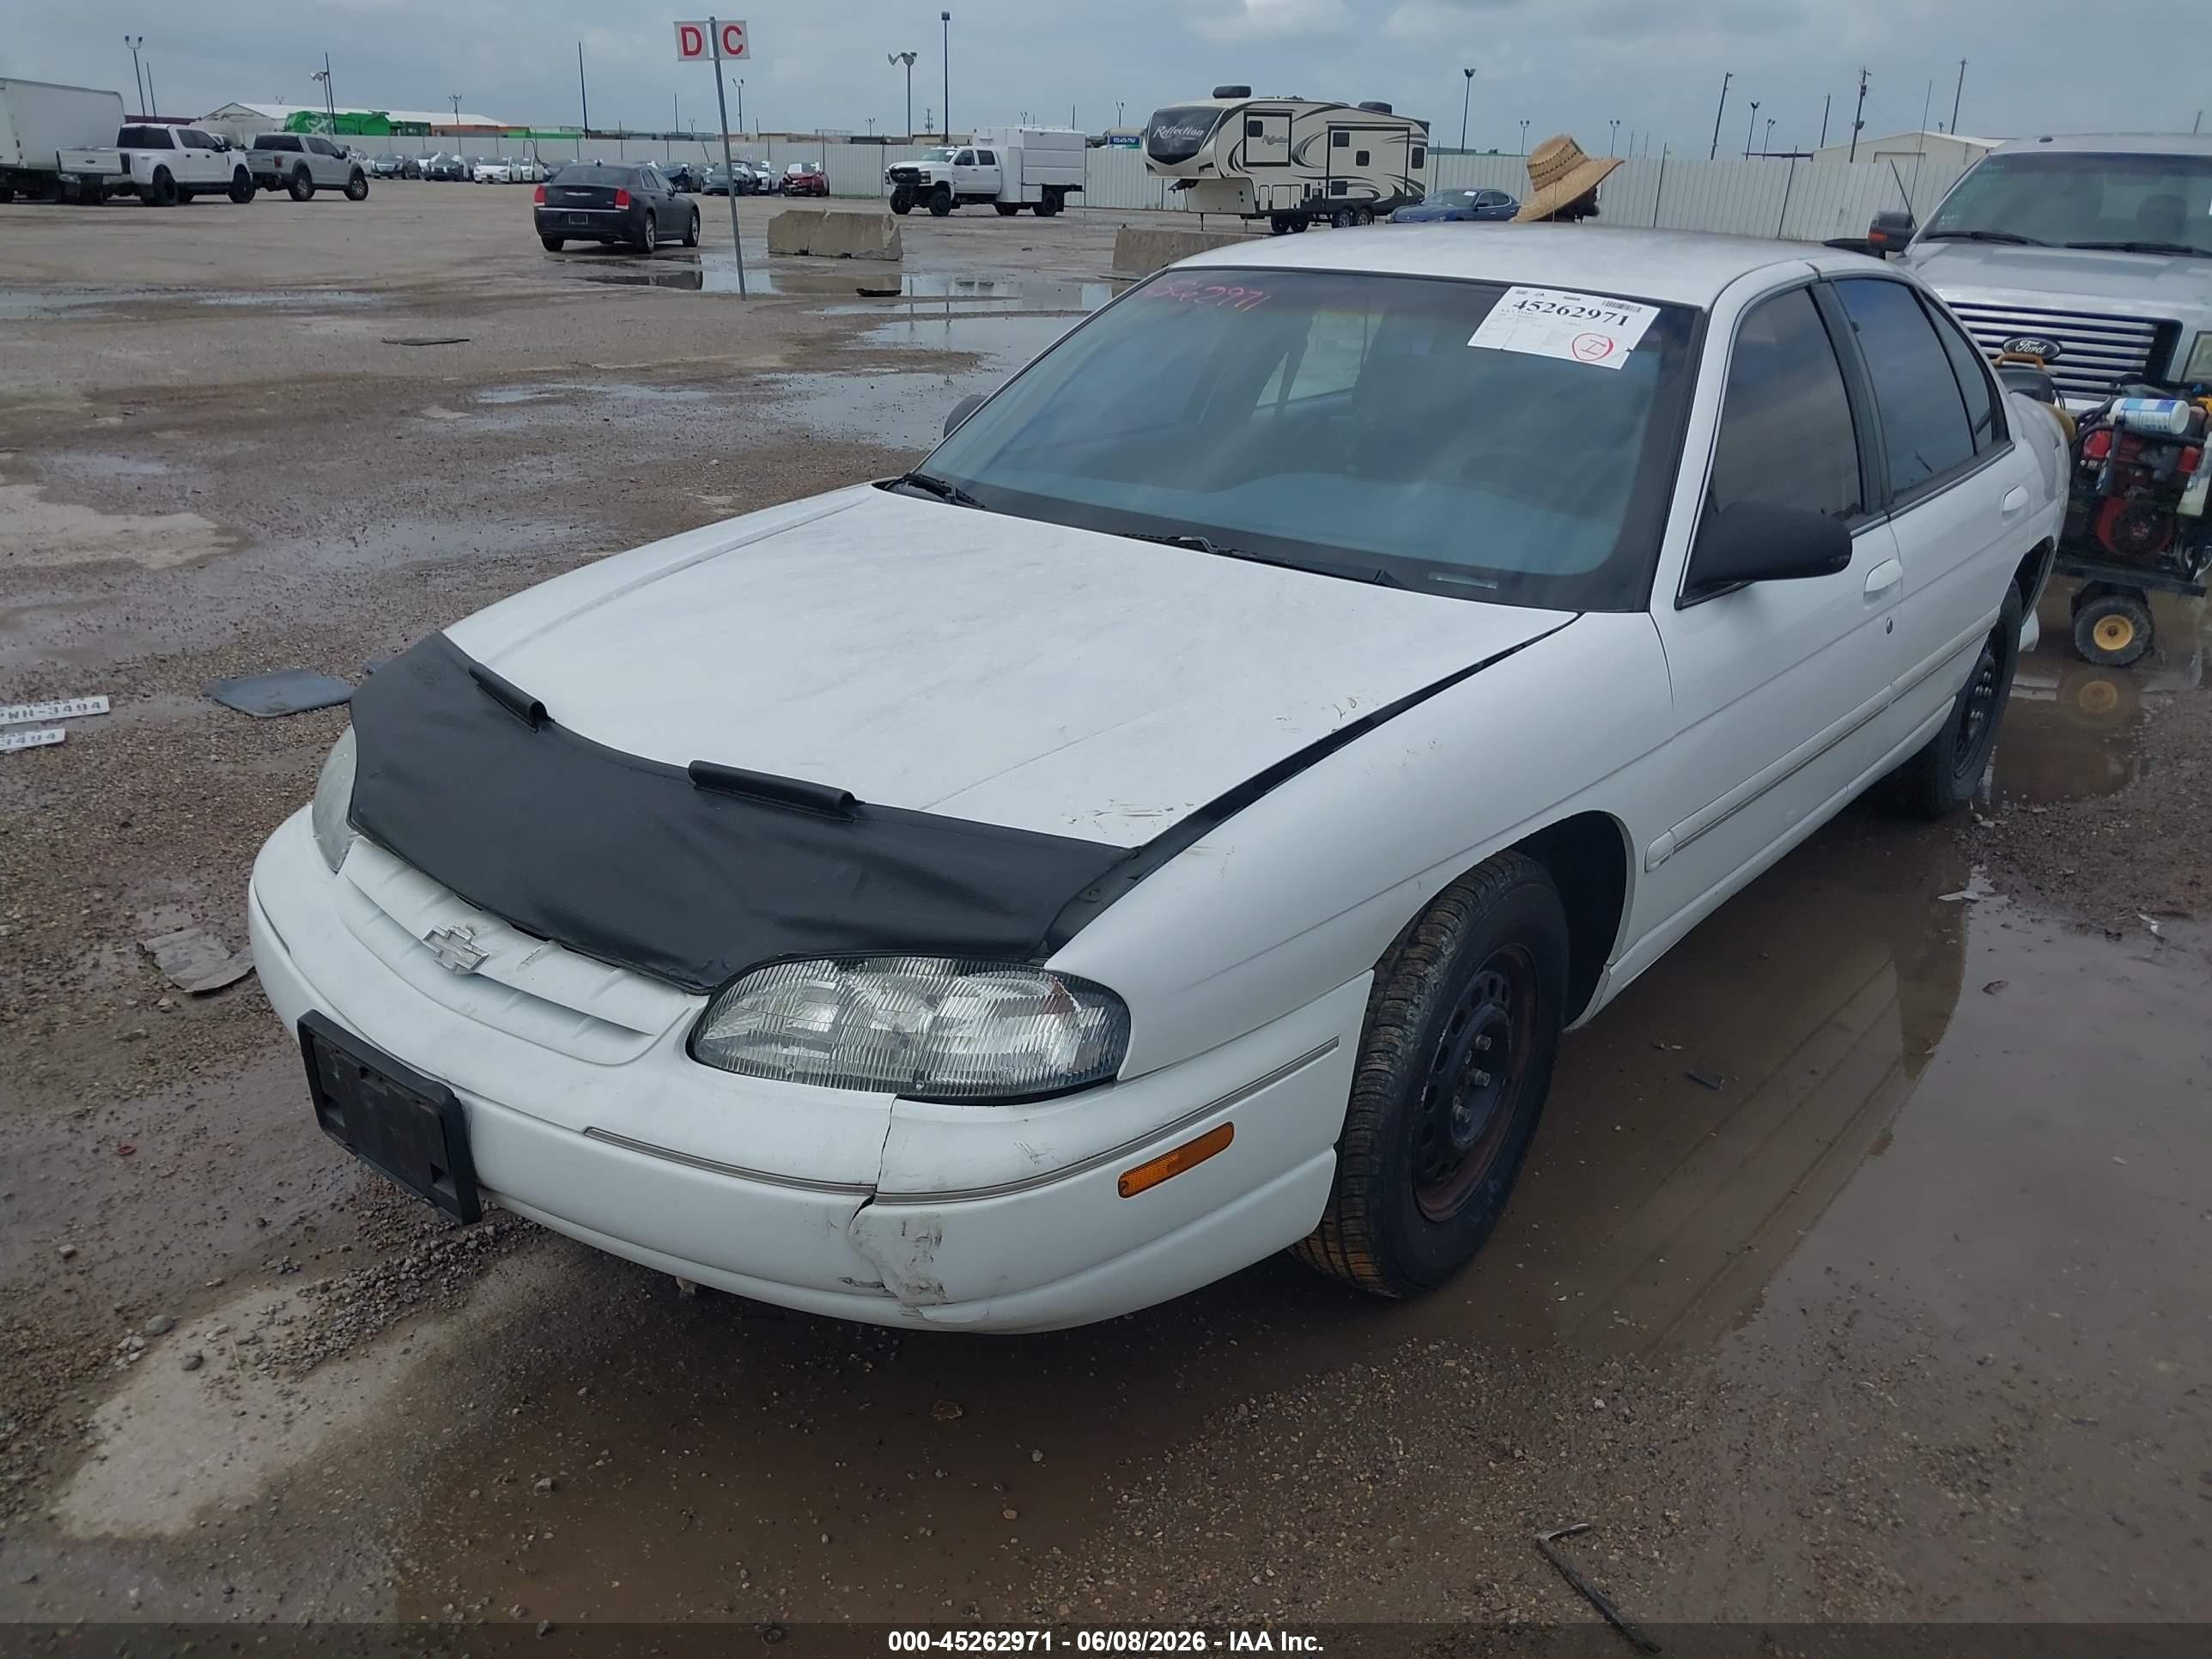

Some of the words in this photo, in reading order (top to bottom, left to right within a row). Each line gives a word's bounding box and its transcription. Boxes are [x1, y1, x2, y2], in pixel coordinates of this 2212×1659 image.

[681, 27, 702, 56] D
[723, 25, 744, 55] C
[1152, 125, 1204, 139] Reflection
[1513, 299, 1629, 327] 45262971
[2014, 339, 2048, 354] Ford
